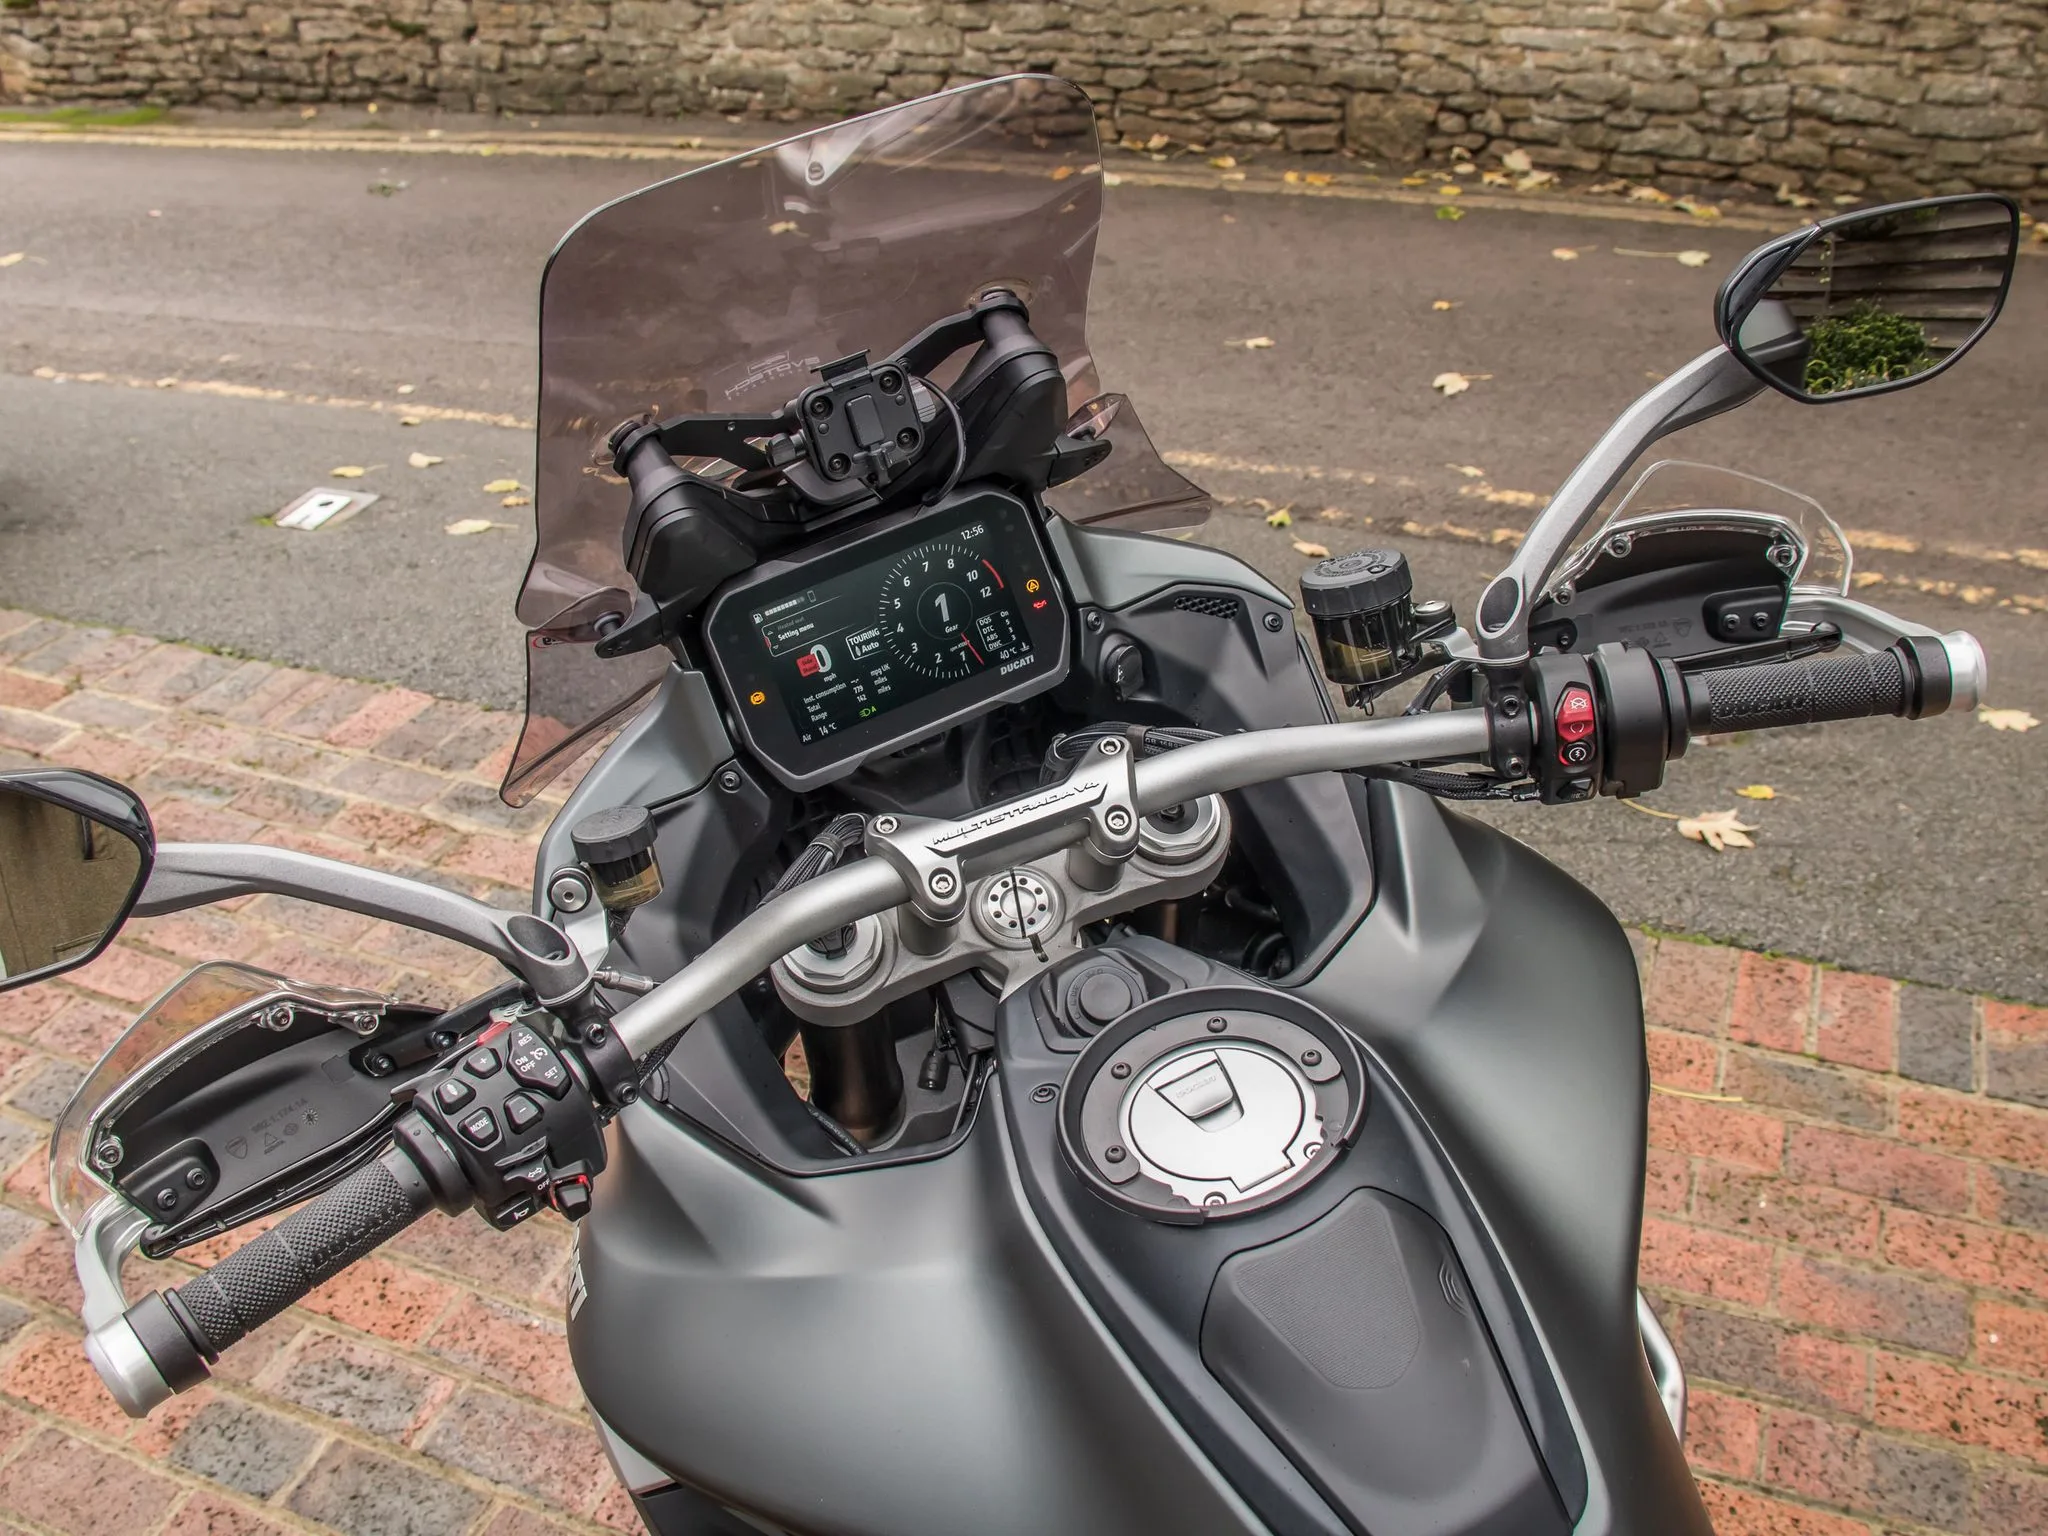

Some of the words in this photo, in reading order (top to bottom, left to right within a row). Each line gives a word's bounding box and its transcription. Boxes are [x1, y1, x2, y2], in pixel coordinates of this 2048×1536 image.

[960, 524, 984, 540] 12:56
[922, 561, 929, 572] 7
[947, 558, 955, 569] 8
[966, 569, 979, 582] 10
[903, 576, 911, 587] 6
[980, 586, 992, 598] 12
[894, 598, 901, 609] 5
[934, 592, 950, 623] 1
[778, 629, 799, 641] Setting
[798, 623, 815, 633] menu
[896, 623, 904, 633] 4
[945, 623, 959, 634] Gear
[982, 625, 995, 634] DTC
[849, 627, 880, 646] TOURING
[986, 633, 998, 642] ABS
[861, 641, 879, 653] Auto
[911, 642, 919, 654] 3
[935, 652, 943, 664] 2
[959, 651, 967, 662] 1
[1000, 649, 1010, 660] 40
[1000, 654, 1035, 676] DUCATI
[824, 673, 837, 682] mph
[815, 682, 847, 700] consumption
[807, 703, 821, 713] Total
[811, 711, 828, 722] Range
[819, 725, 829, 736] 14
[802, 733, 811, 742] Air
[518, 1033, 532, 1047] RES
[515, 1056, 528, 1066] ON
[520, 1060, 536, 1072] OFF
[544, 1066, 558, 1079] SET
[469, 1116, 490, 1134] MODE
